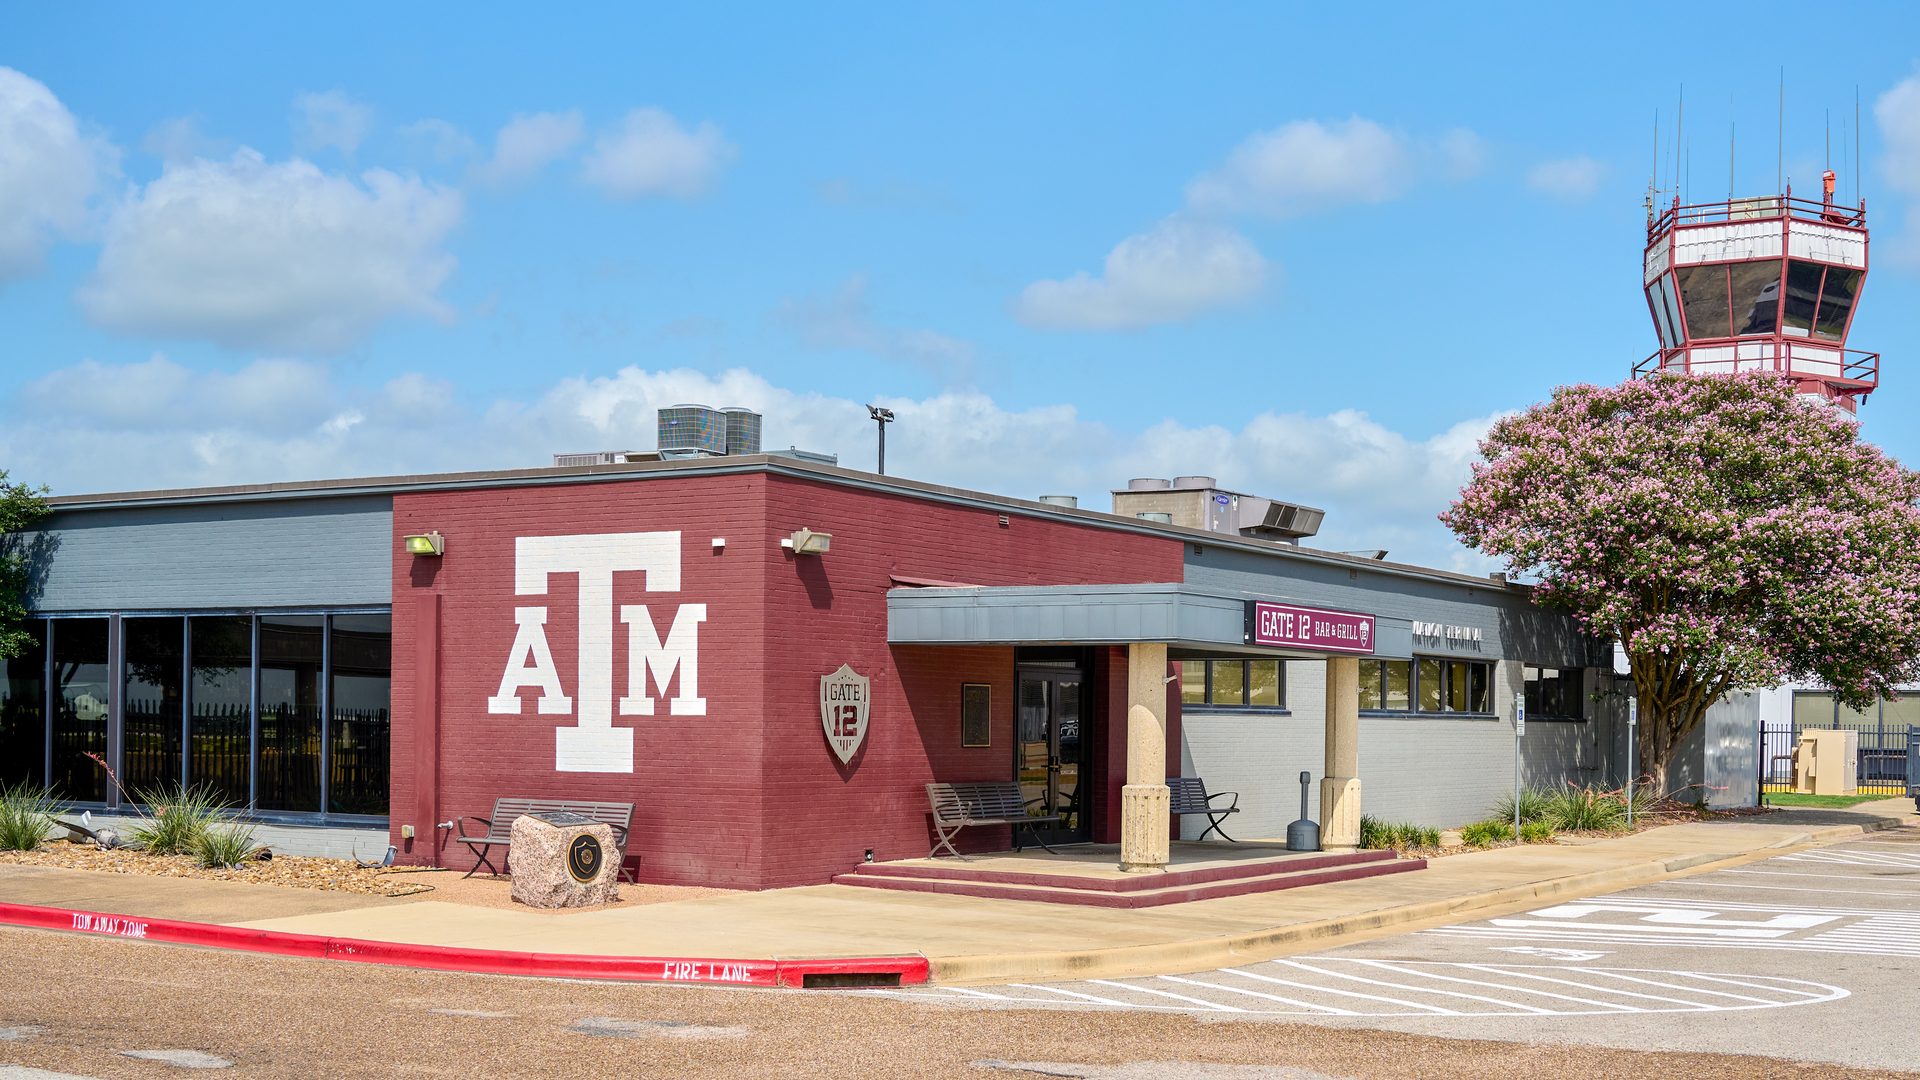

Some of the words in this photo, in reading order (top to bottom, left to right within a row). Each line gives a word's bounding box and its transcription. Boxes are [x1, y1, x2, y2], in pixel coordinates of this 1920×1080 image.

[1261, 610, 1294, 638] GATE
[1298, 614, 1311, 640] 12
[1315, 621, 1330, 637] BAR
[1331, 625, 1336, 636] &
[1337, 624, 1358, 640] GRILL
[830, 683, 860, 701] GATE
[833, 705, 858, 737] 12
[72, 913, 92, 930] TOW
[93, 916, 119, 933] AWAY
[121, 919, 149, 938] ZONE
[662, 962, 702, 979] FIRE
[709, 962, 753, 982] LANE
